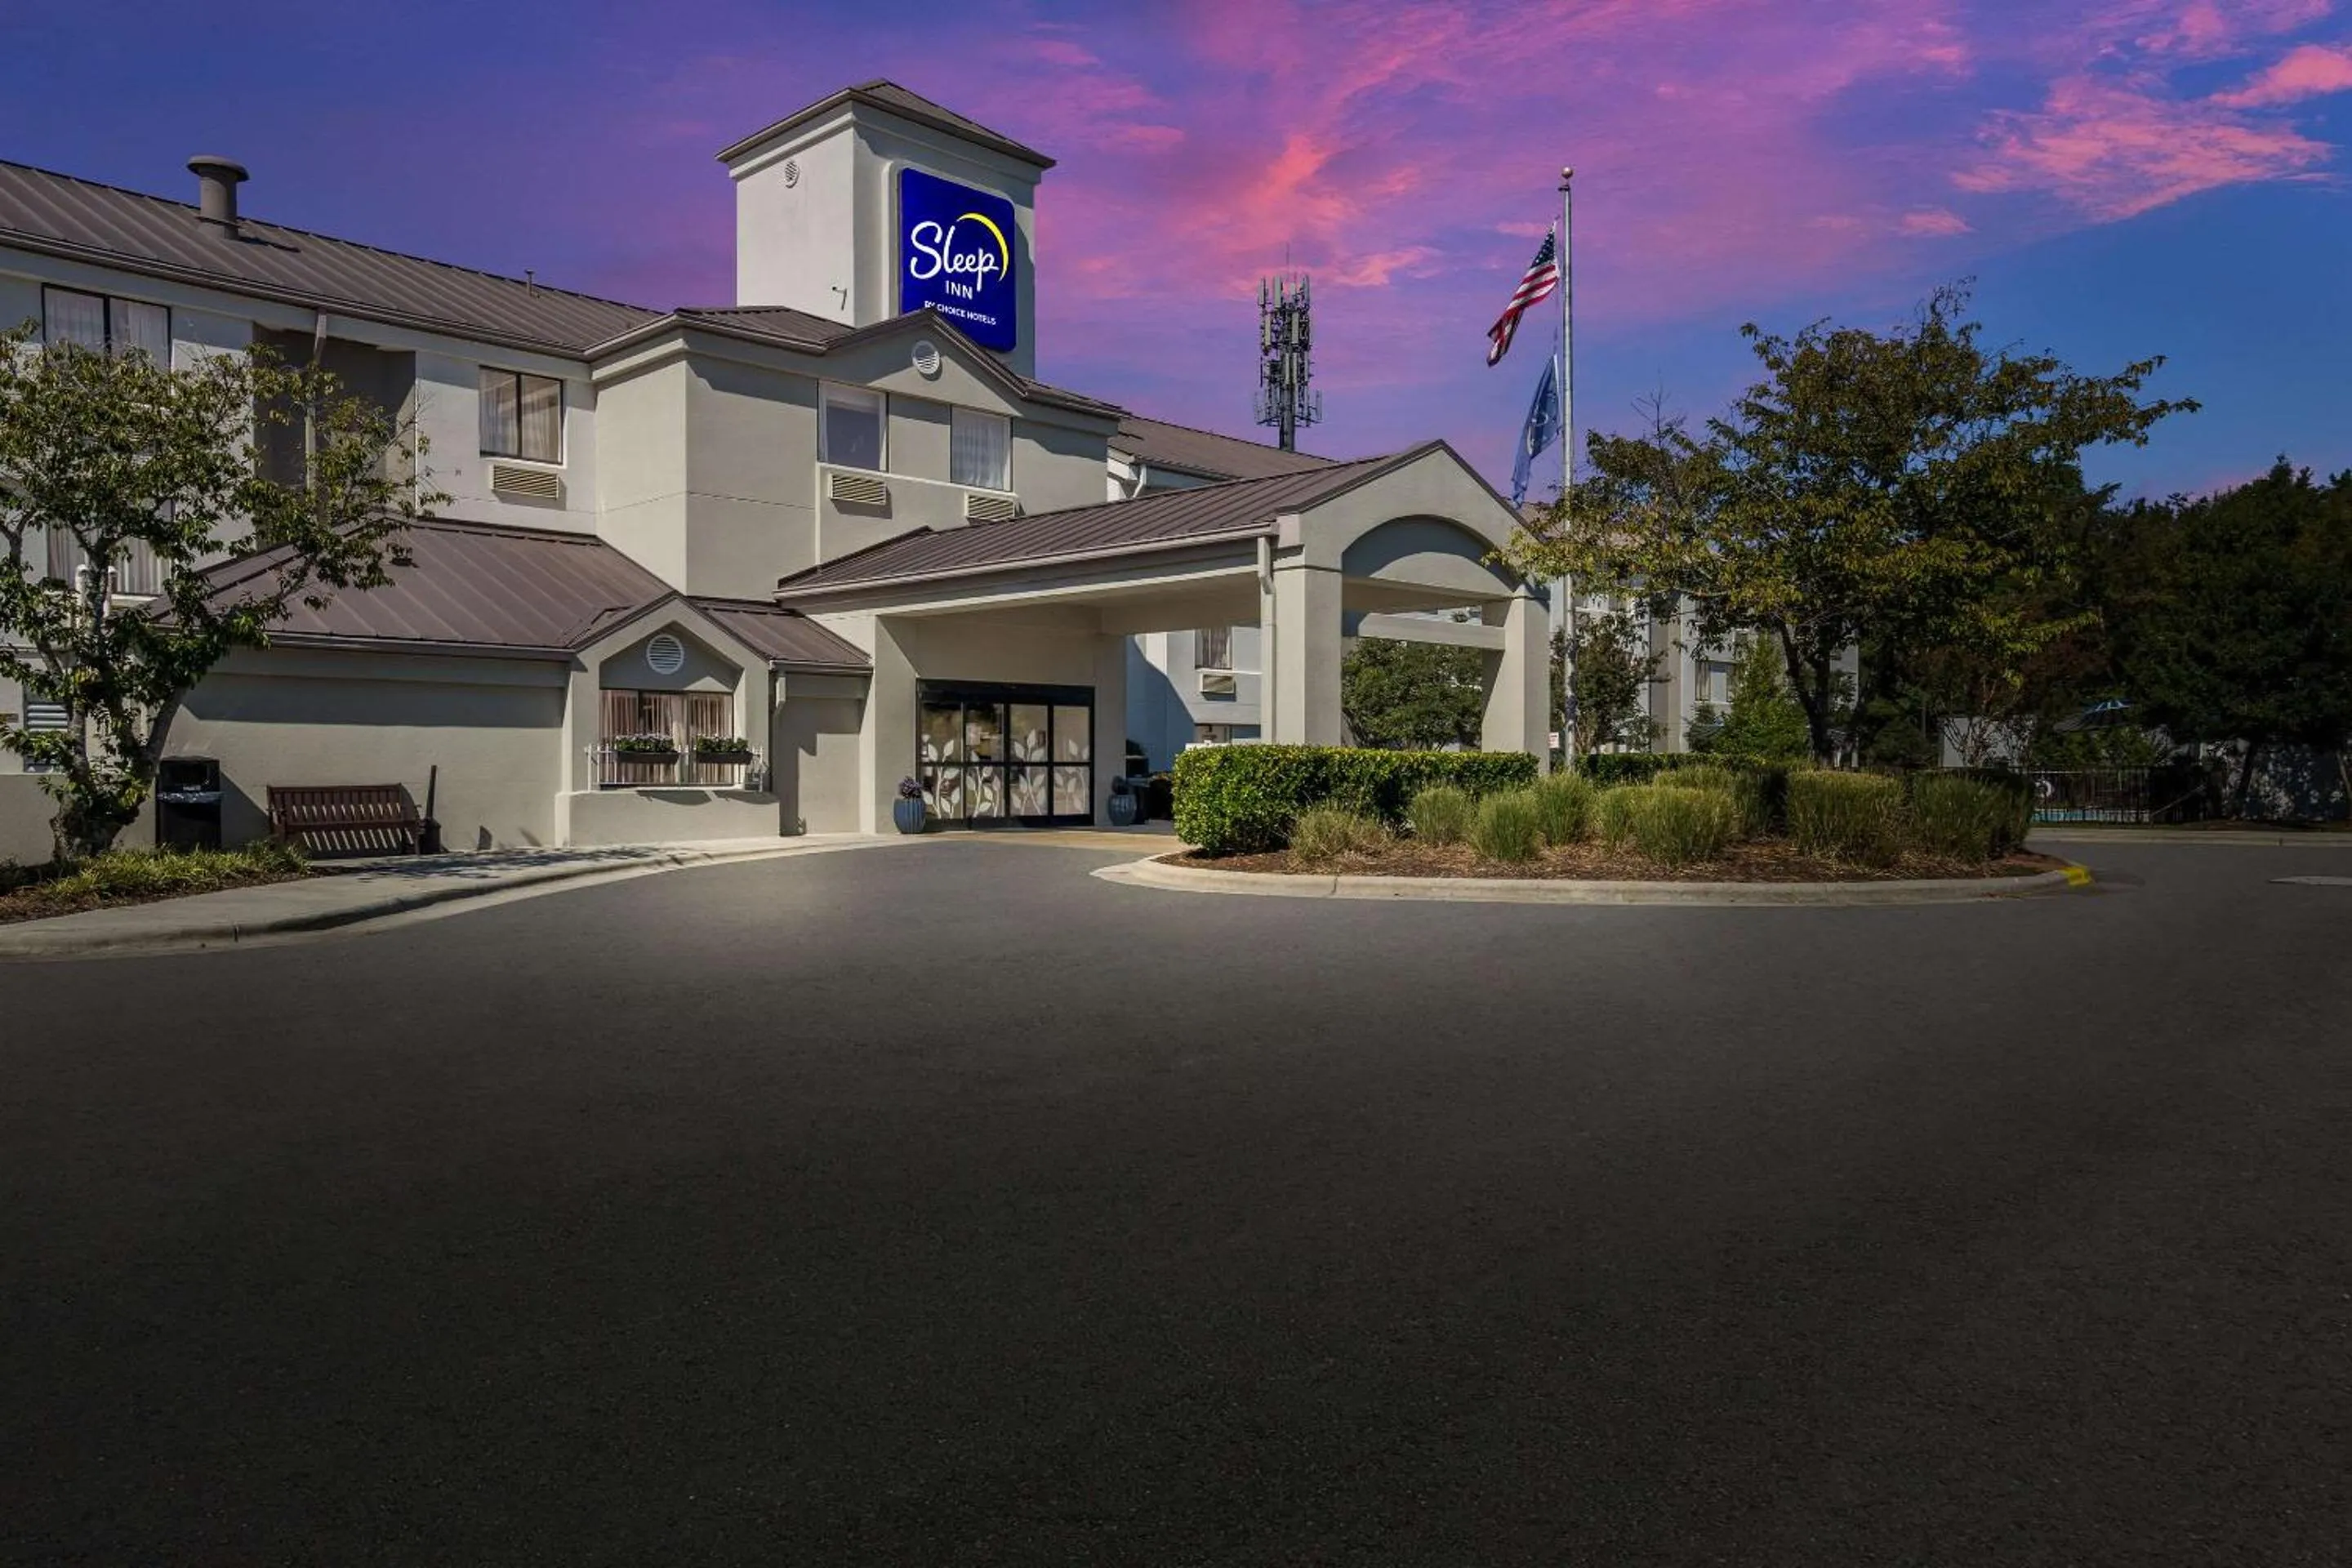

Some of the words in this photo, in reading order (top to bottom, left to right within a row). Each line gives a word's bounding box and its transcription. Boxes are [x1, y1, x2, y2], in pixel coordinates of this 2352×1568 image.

[910, 220, 1000, 292] Sleep
[945, 280, 973, 300] INN
[937, 304, 965, 318] CHOICE
[967, 311, 996, 325] HOTELS
